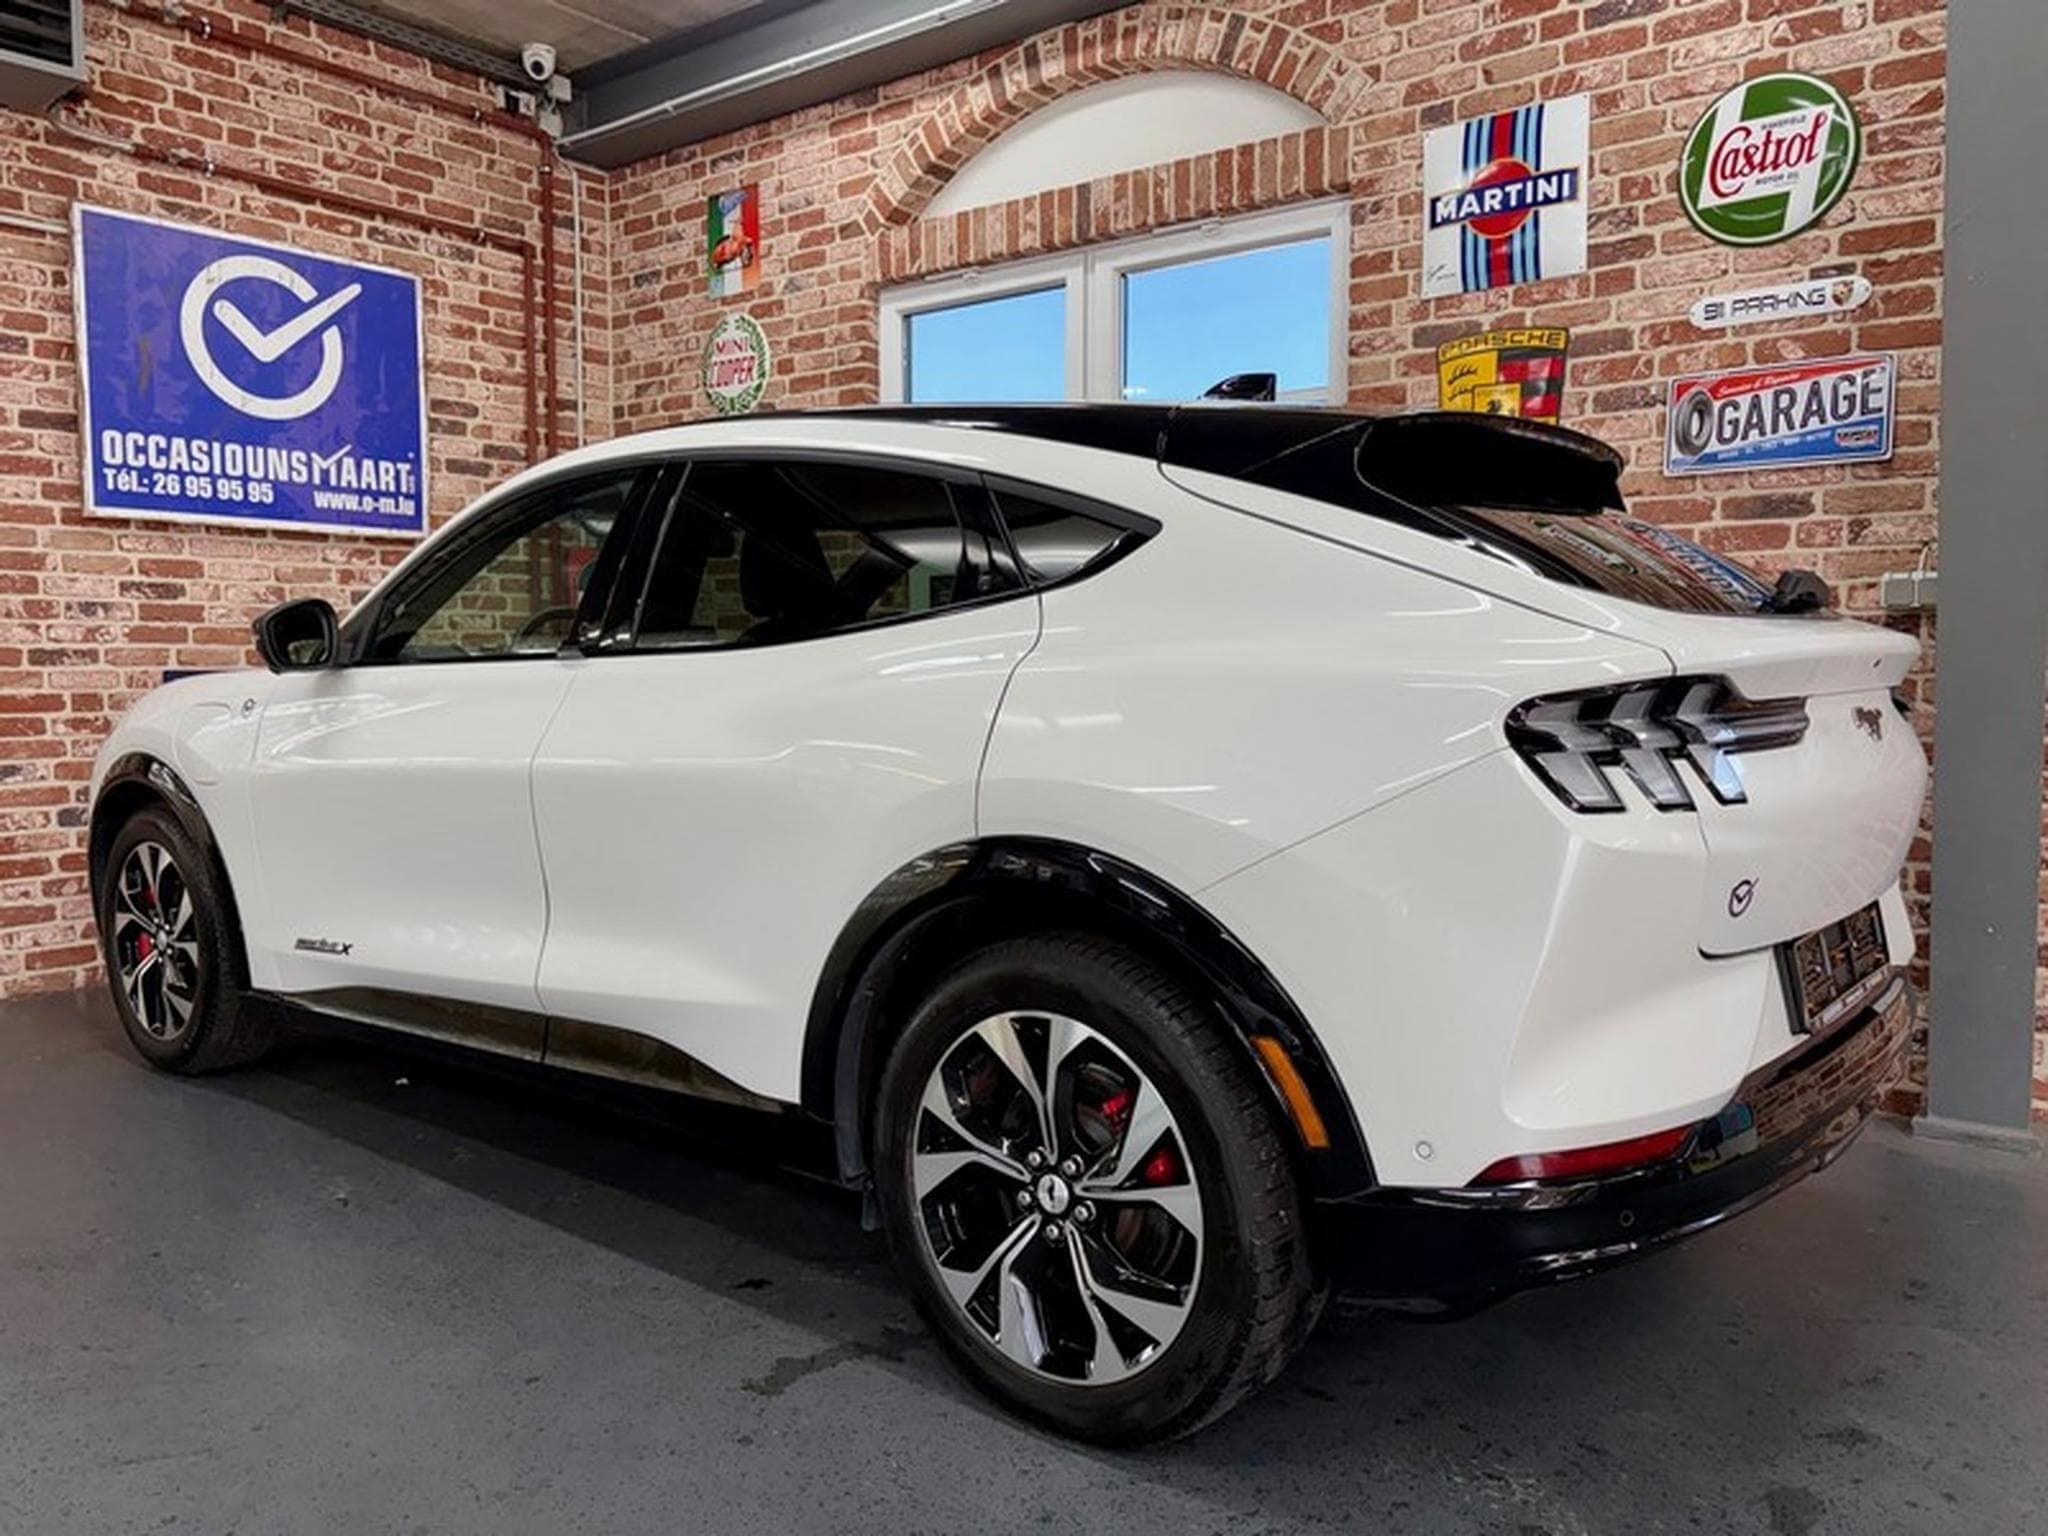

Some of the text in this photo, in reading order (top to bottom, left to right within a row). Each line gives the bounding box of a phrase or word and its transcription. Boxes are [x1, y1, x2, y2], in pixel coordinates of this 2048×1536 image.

[1709, 111, 1828, 199] Castrol
[1435, 173, 1571, 224] MARTINI
[1731, 287, 1826, 317] PARKING
[1440, 331, 1562, 358] PORSCHE
[1716, 366, 1885, 445] GARAGE
[153, 472, 181, 496] 26
[185, 475, 213, 499] 95
[216, 478, 244, 502] 95
[247, 481, 274, 504] 95
[313, 490, 415, 516] www.o-m.lu
